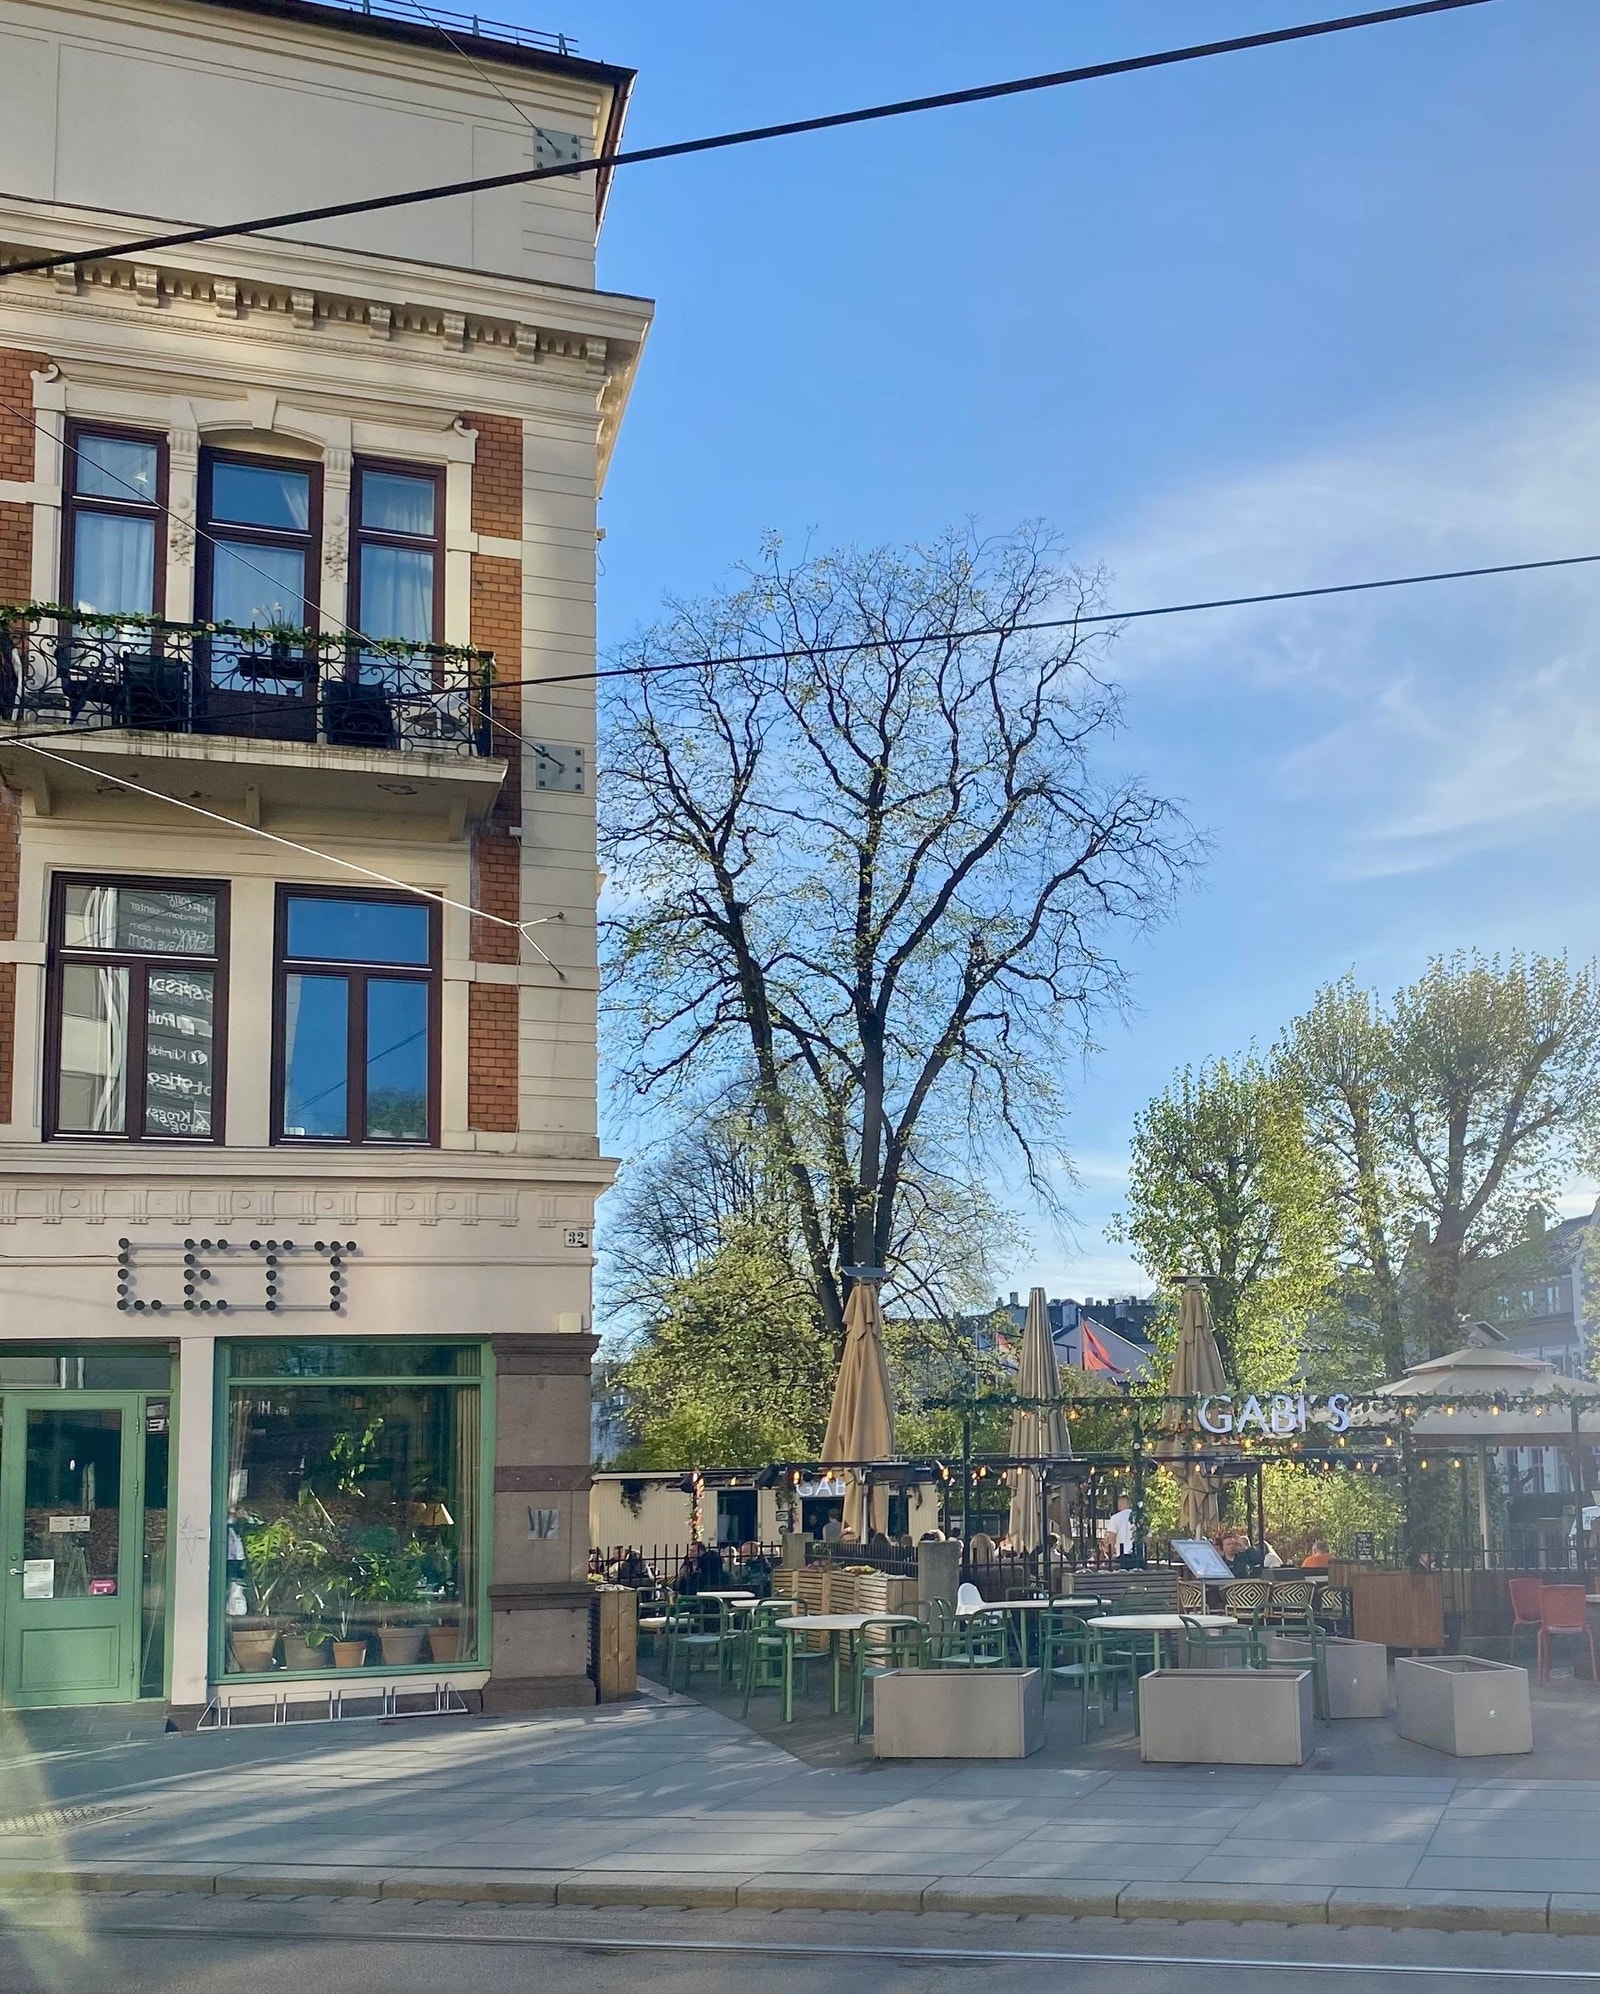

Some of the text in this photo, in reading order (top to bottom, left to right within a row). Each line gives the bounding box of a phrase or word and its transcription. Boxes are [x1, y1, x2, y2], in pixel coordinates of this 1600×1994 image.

[568, 1231, 584, 1245] 32
[117, 1238, 357, 1311] LETT
[1197, 1393, 1351, 1434] GABI'S
